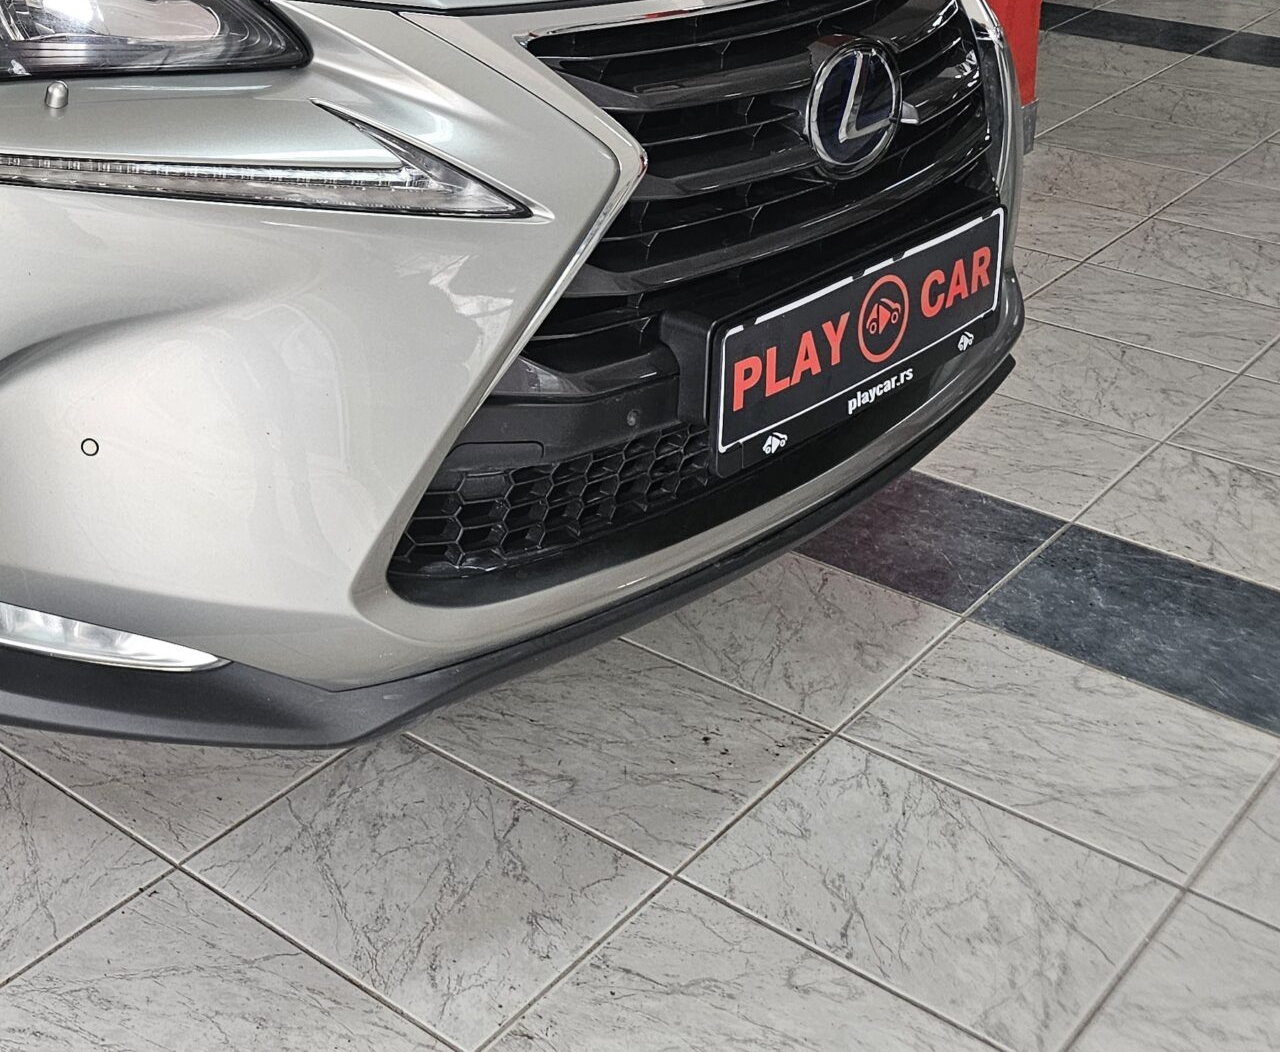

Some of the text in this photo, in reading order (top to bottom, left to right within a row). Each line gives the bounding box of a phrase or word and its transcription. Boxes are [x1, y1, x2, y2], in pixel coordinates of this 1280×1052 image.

[732, 246, 992, 412] PLAY CAR
[847, 367, 914, 415] playcar.rs
